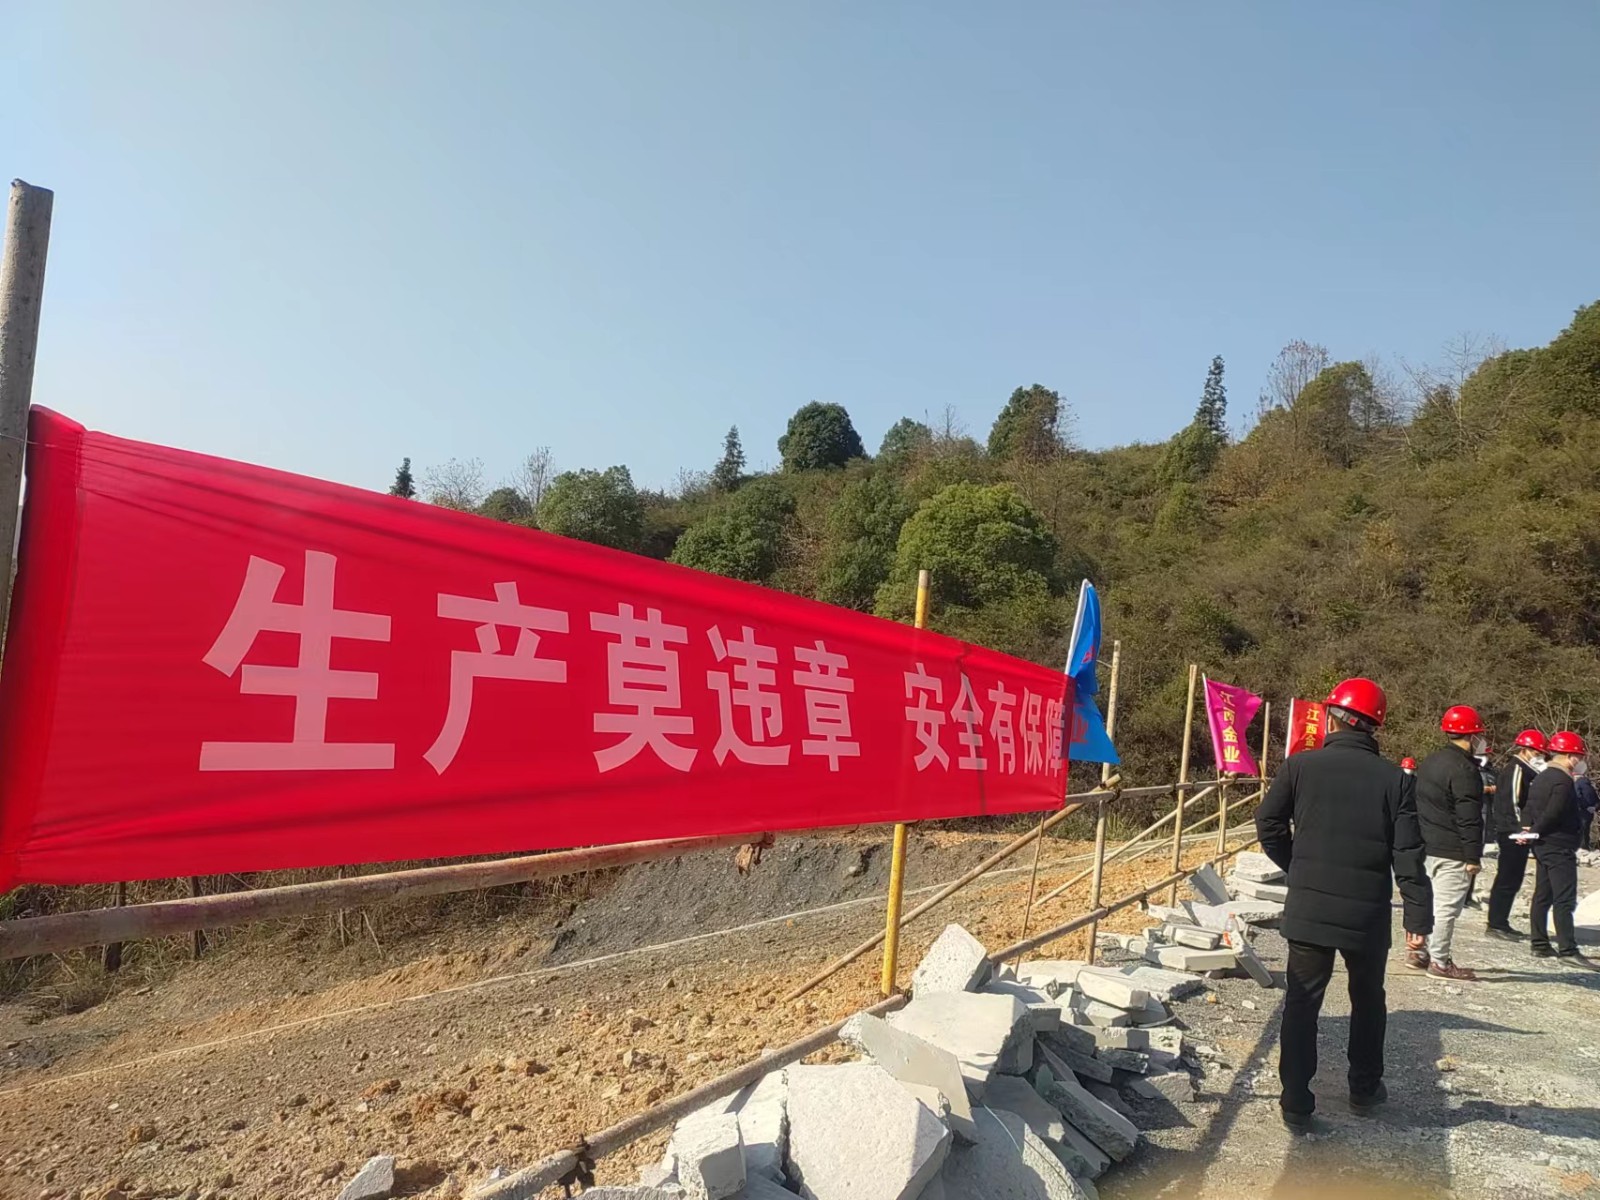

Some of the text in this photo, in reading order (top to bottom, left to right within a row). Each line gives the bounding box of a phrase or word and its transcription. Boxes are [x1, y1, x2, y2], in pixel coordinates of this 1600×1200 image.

[199, 550, 861, 775] 生产莫违章
[903, 662, 1066, 777] 安全有保障
[1220, 691, 1240, 763] 江西金业
[1304, 708, 1319, 751] 江西金
